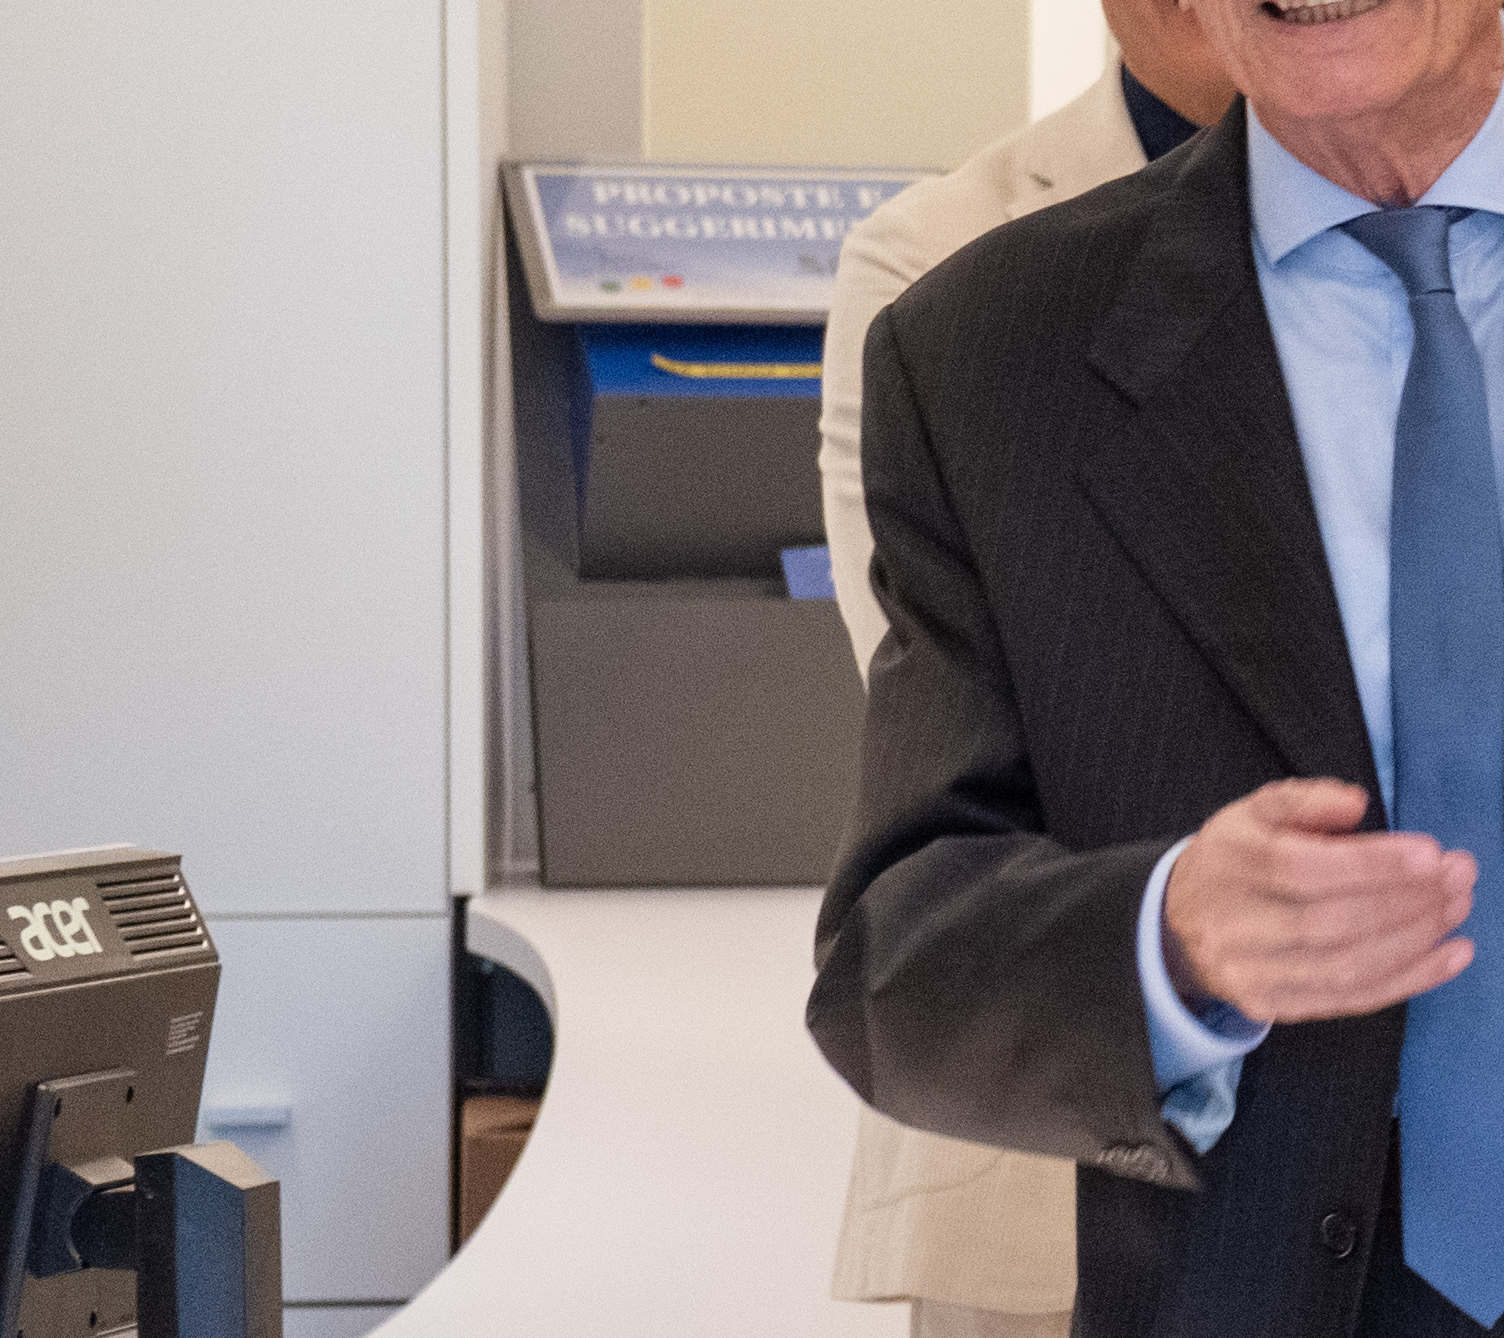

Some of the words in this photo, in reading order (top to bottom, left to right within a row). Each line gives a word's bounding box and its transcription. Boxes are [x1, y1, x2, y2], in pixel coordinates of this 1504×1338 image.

[591, 180, 845, 210] PROPOSTE
[564, 212, 850, 242] SUGGERIME
[7, 897, 103, 961] acer
